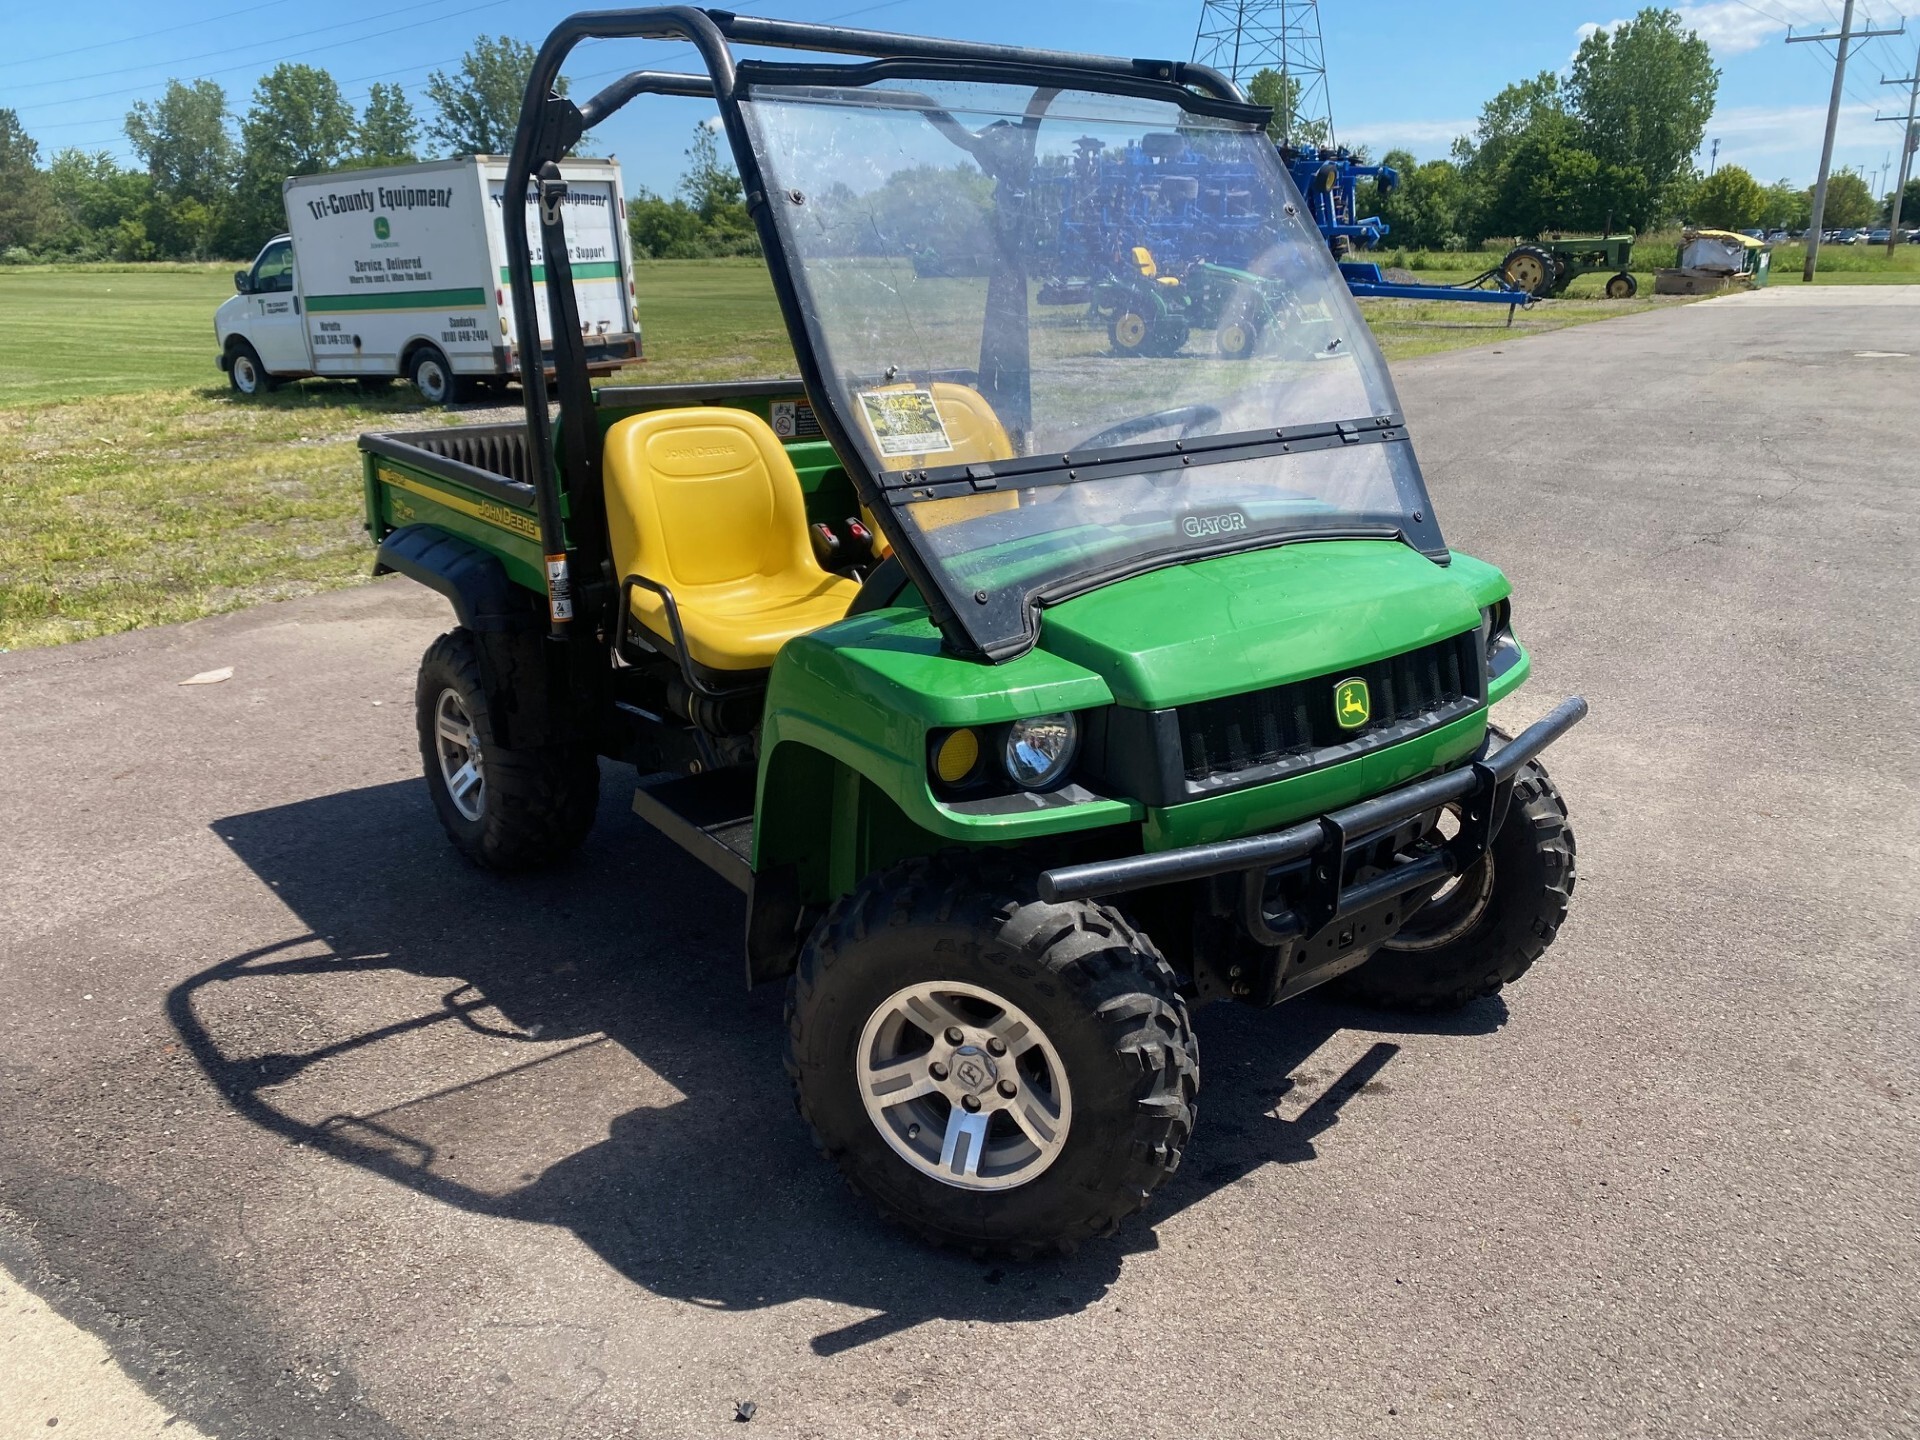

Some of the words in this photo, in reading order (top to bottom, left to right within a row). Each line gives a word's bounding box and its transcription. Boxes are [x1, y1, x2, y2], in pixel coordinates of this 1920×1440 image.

[307, 189, 374, 220] Tri-County
[378, 186, 453, 211] Equipment
[560, 190, 607, 207] quipment
[575, 245, 606, 260] Support
[354, 260, 385, 274] Service,
[386, 256, 422, 272] Delivered
[449, 316, 476, 329] Sandusky
[665, 447, 696, 460] JOHN
[698, 444, 736, 458] DEERE
[479, 500, 502, 522] JOHN
[503, 508, 535, 534] DEERE
[1182, 512, 1247, 538] GATOR
